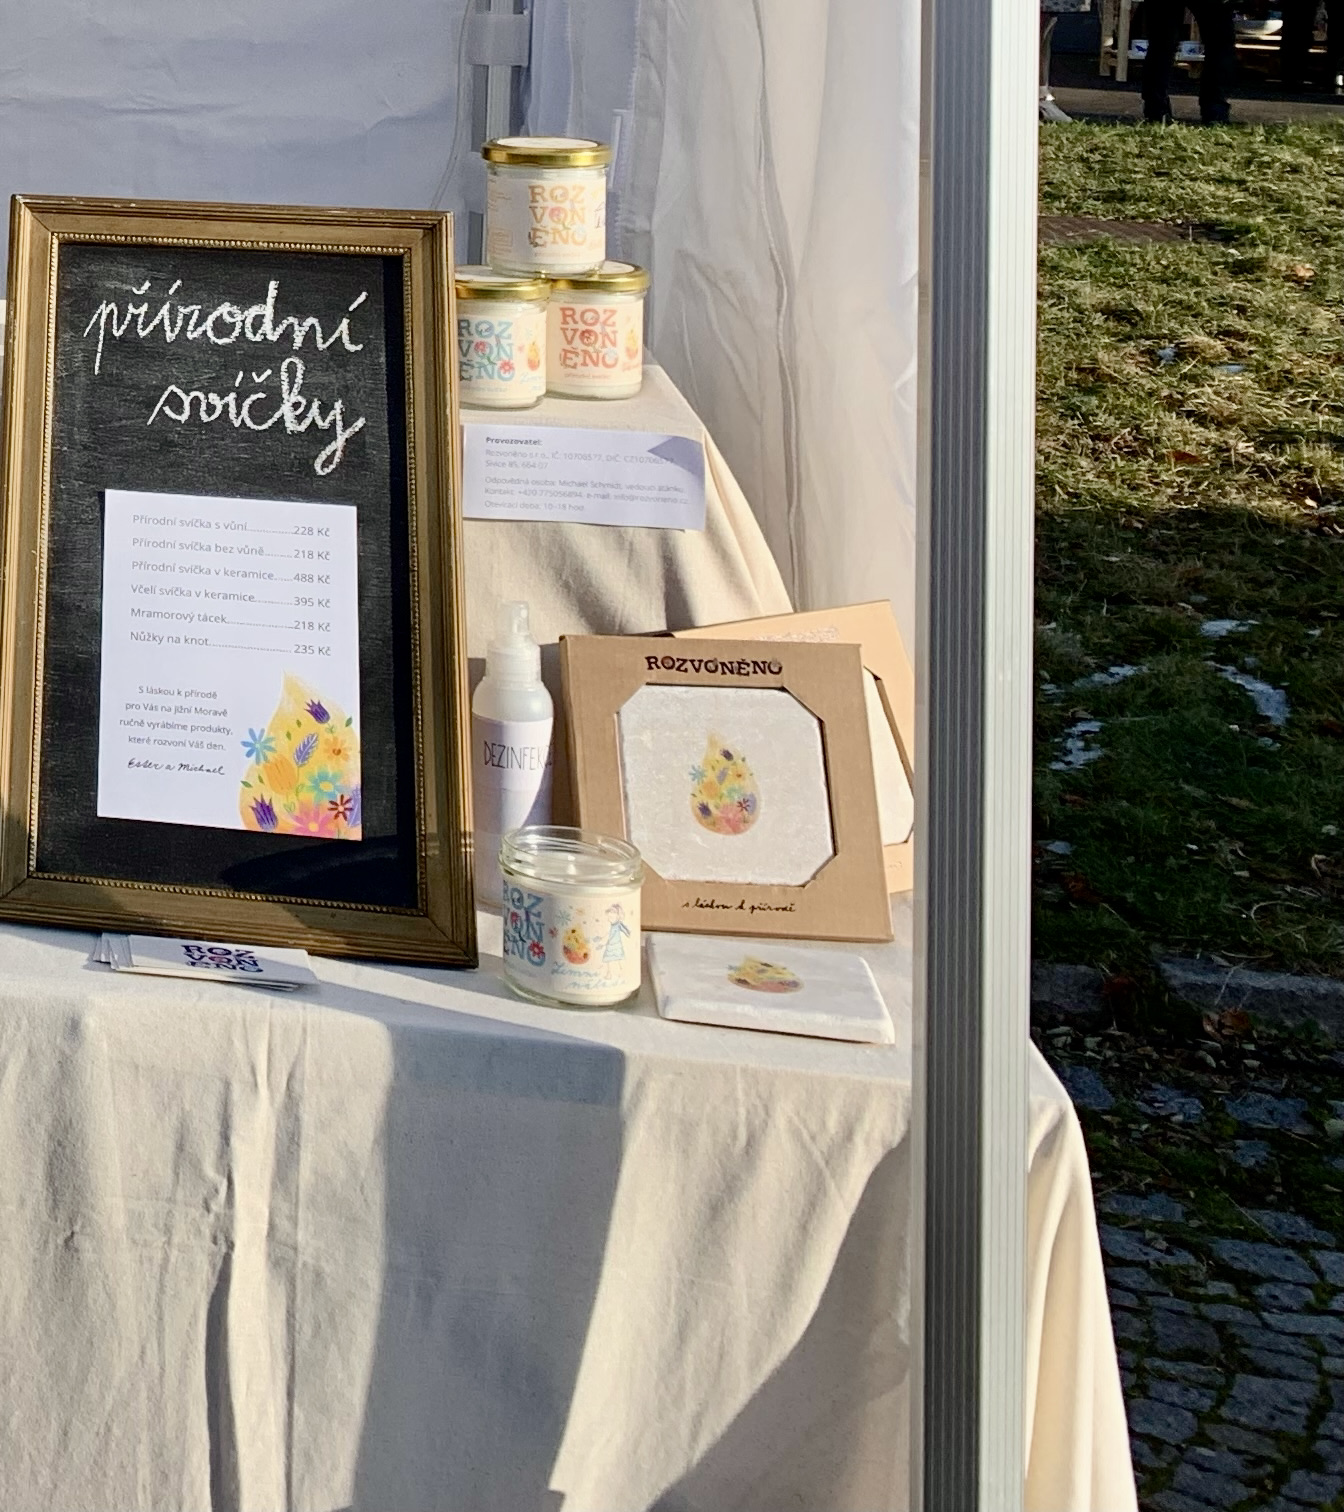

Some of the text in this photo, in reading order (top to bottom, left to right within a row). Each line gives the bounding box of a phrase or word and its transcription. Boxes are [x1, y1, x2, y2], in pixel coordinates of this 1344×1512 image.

[528, 184, 586, 204] ROZ
[529, 206, 586, 225] VON
[83, 279, 368, 375] přírodní
[560, 307, 618, 328] ROZ
[457, 319, 513, 340] ROZ
[560, 328, 618, 349] VON
[457, 340, 513, 361] VON
[147, 356, 366, 476] svíčky
[485, 436, 543, 446] Provozovatel:
[132, 514, 177, 527] Přírodní
[179, 517, 212, 529] svíčka
[215, 522, 221, 530] s
[293, 525, 314, 536] 228
[317, 527, 330, 537] Kč
[132, 537, 177, 550] Přírodní
[178, 541, 212, 553] svíčka
[214, 543, 234, 554] bez
[293, 549, 314, 560] 218
[317, 550, 331, 561] Kč
[131, 560, 176, 574] Přírodní
[178, 564, 212, 576] svíčka
[223, 567, 274, 581] keramice
[293, 572, 314, 583] 488
[317, 574, 331, 585] Kč
[130, 583, 156, 595] Včelí
[158, 586, 192, 598] svíčka
[204, 589, 256, 603] keramice
[293, 596, 314, 607] 395
[317, 598, 331, 609] Kč
[130, 607, 195, 624] Mramorový
[293, 620, 314, 631] 218
[318, 621, 331, 632] Kč
[130, 630, 164, 646] Nůžky
[167, 635, 181, 645] na
[293, 644, 315, 655] 235
[318, 646, 332, 656] Kč
[645, 655, 783, 677] ROZVONĚNO
[138, 686, 218, 700] S láskou k přírodě
[125, 703, 228, 717] pro Vás na jižní Moravě
[119, 718, 233, 736] ručně vyrábíme produkty,
[128, 735, 226, 751] které rozvoní Váš den.
[503, 907, 546, 943] ON
[181, 944, 255, 958] ROZ
